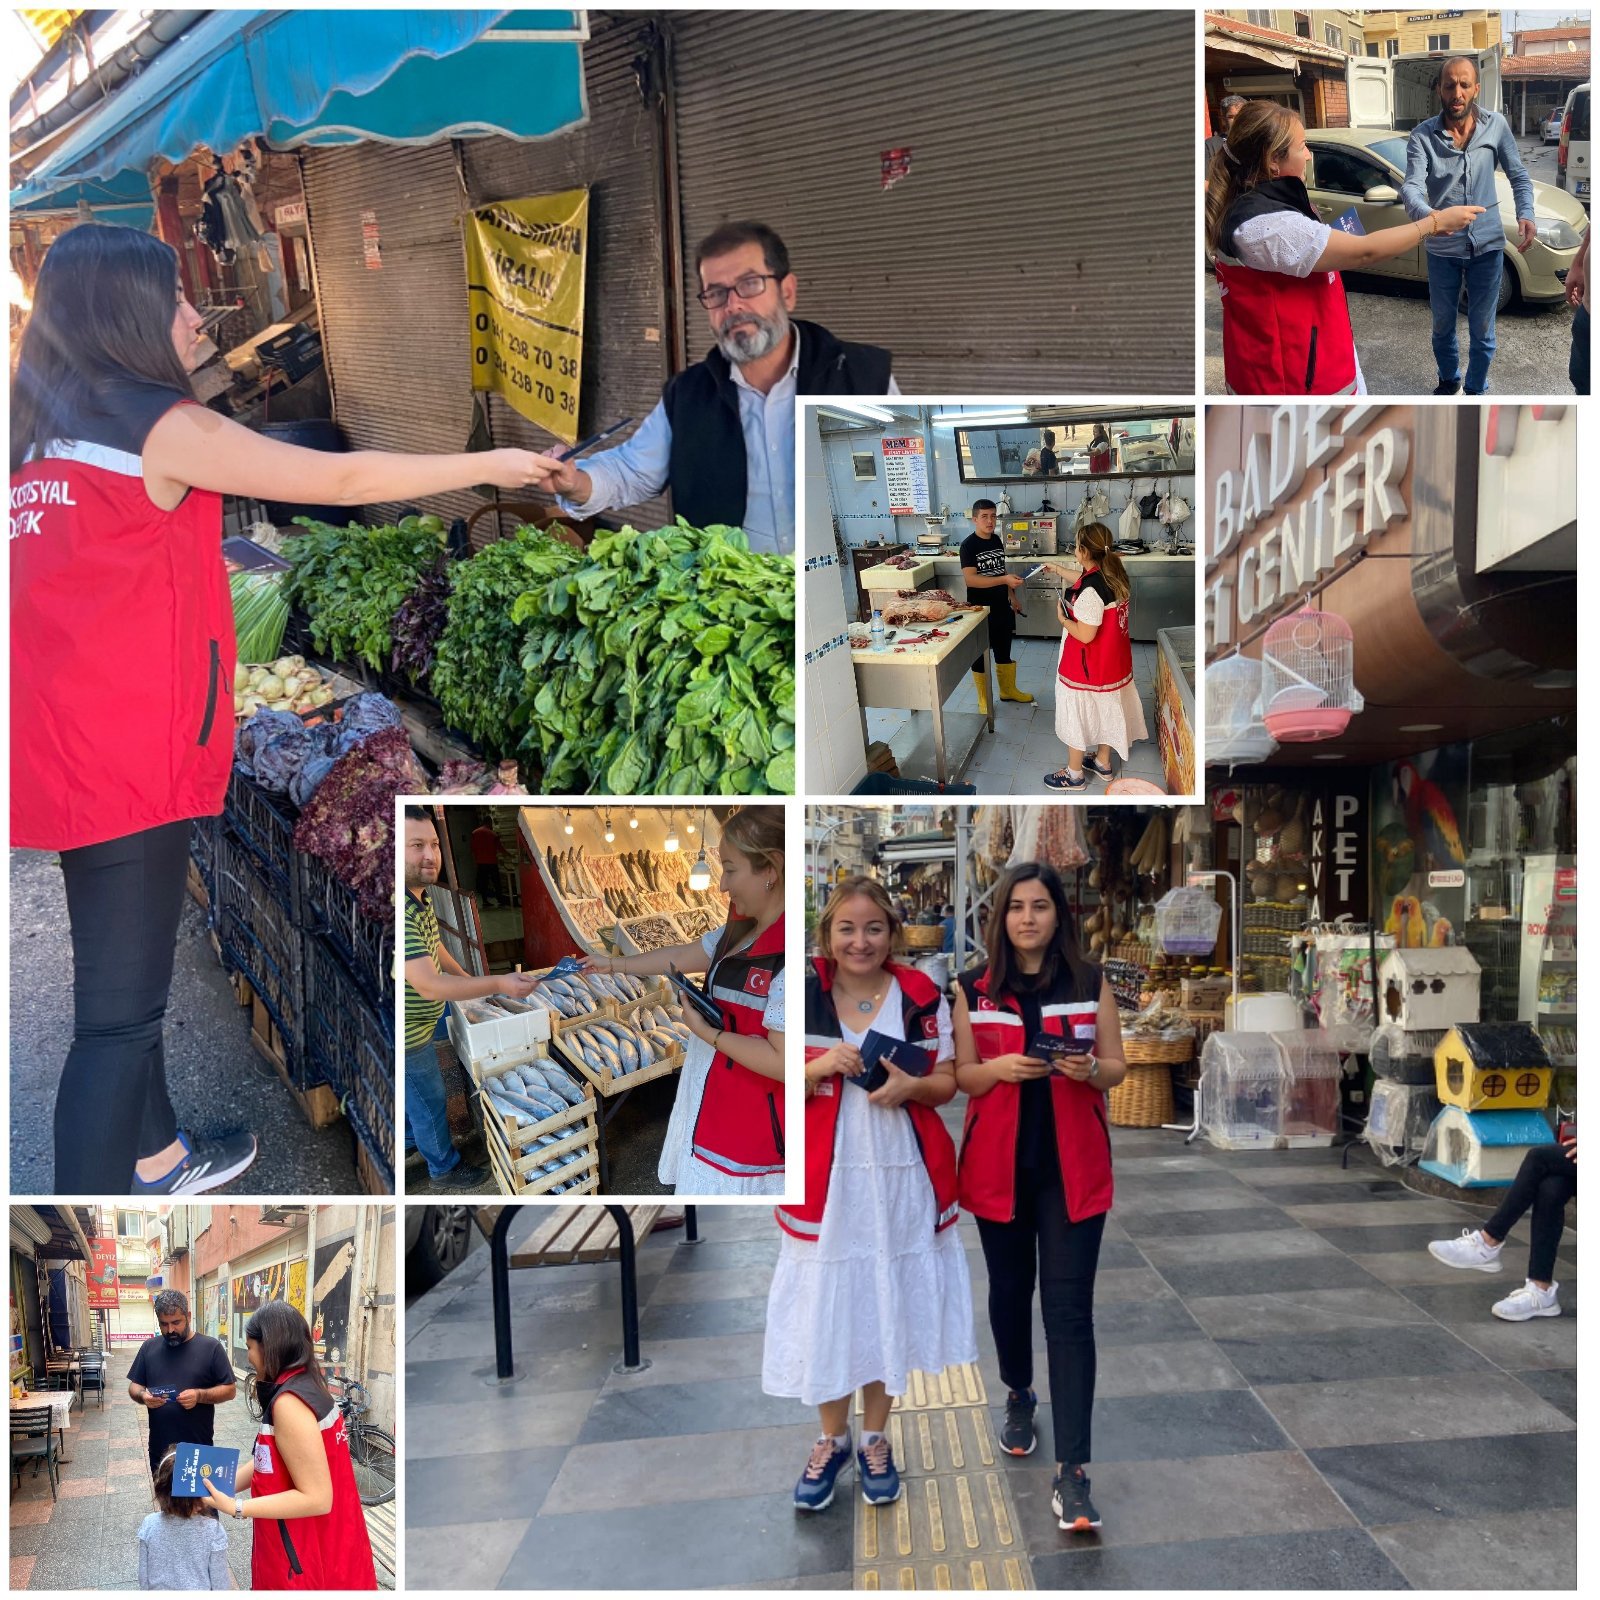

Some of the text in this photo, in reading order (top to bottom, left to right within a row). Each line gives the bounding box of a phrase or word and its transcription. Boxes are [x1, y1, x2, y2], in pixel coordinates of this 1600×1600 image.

[476, 313, 488, 331] 0
[508, 333, 529, 360] 238
[533, 346, 552, 370] 70
[558, 356, 578, 379] 38
[476, 346, 488, 366] 0
[510, 366, 532, 394] 238
[536, 380, 554, 404] 70
[560, 391, 576, 416] 38
[1213, 405, 1393, 558] BADE
[1238, 427, 1410, 625] CENTER
[1332, 794, 1359, 902] PET
